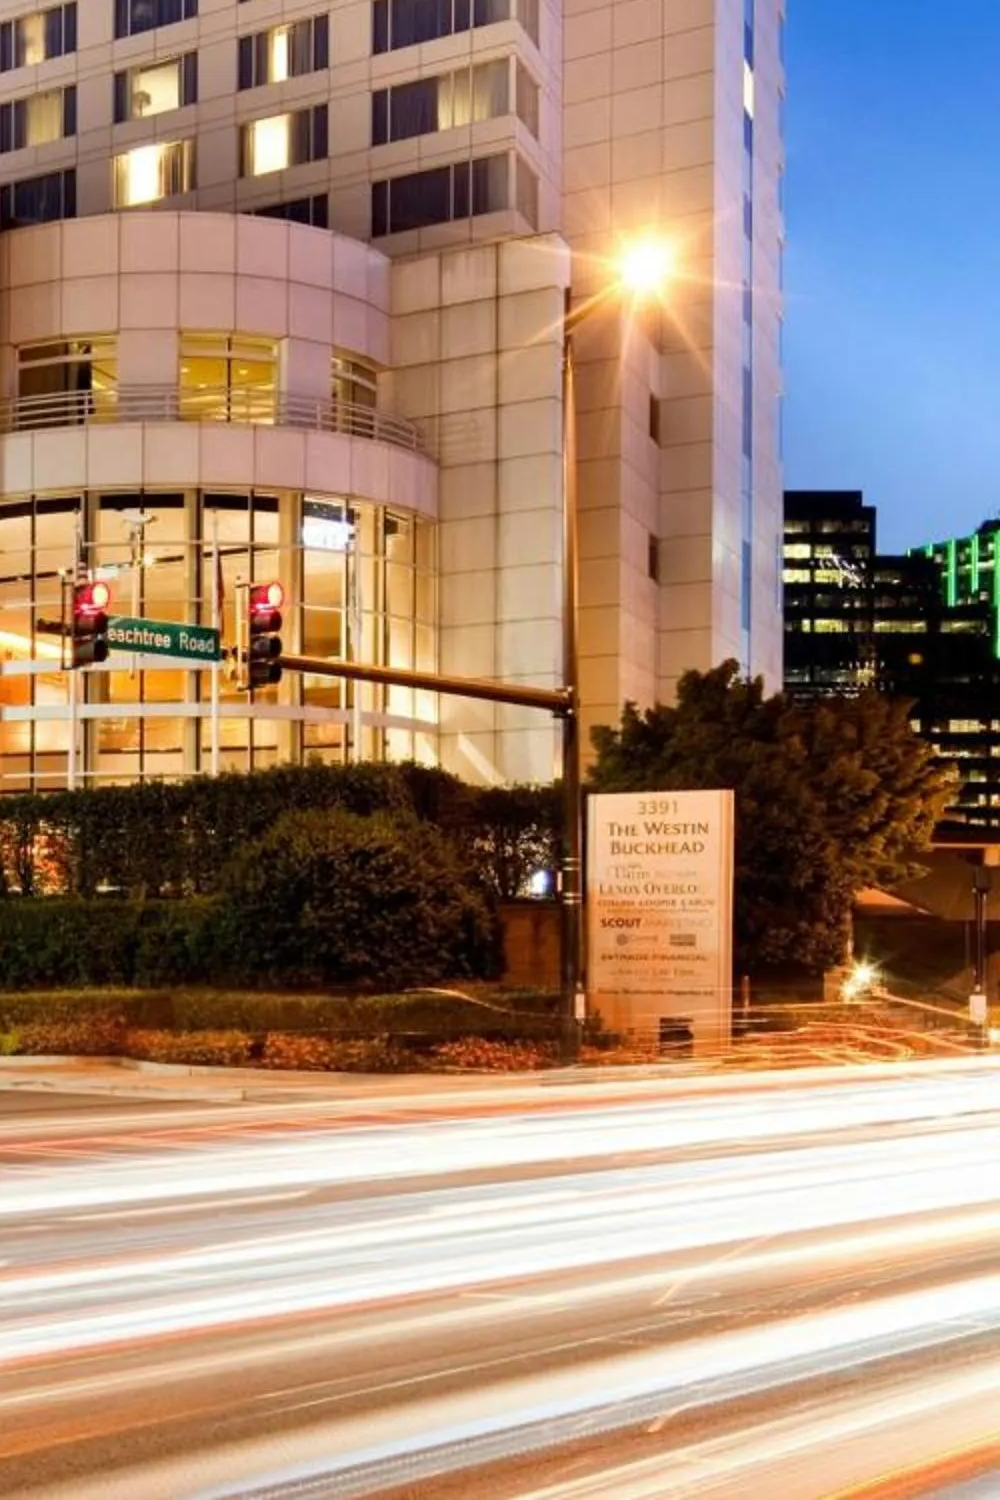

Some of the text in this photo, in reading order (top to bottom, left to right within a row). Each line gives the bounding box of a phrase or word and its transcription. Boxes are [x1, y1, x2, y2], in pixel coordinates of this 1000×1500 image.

[106, 627, 215, 654] eachtree Road
[638, 800, 678, 815] 3391
[607, 821, 709, 837] THE WESTIN
[610, 841, 705, 855] BUCKHEAD
[600, 917, 641, 929] SCOUT
